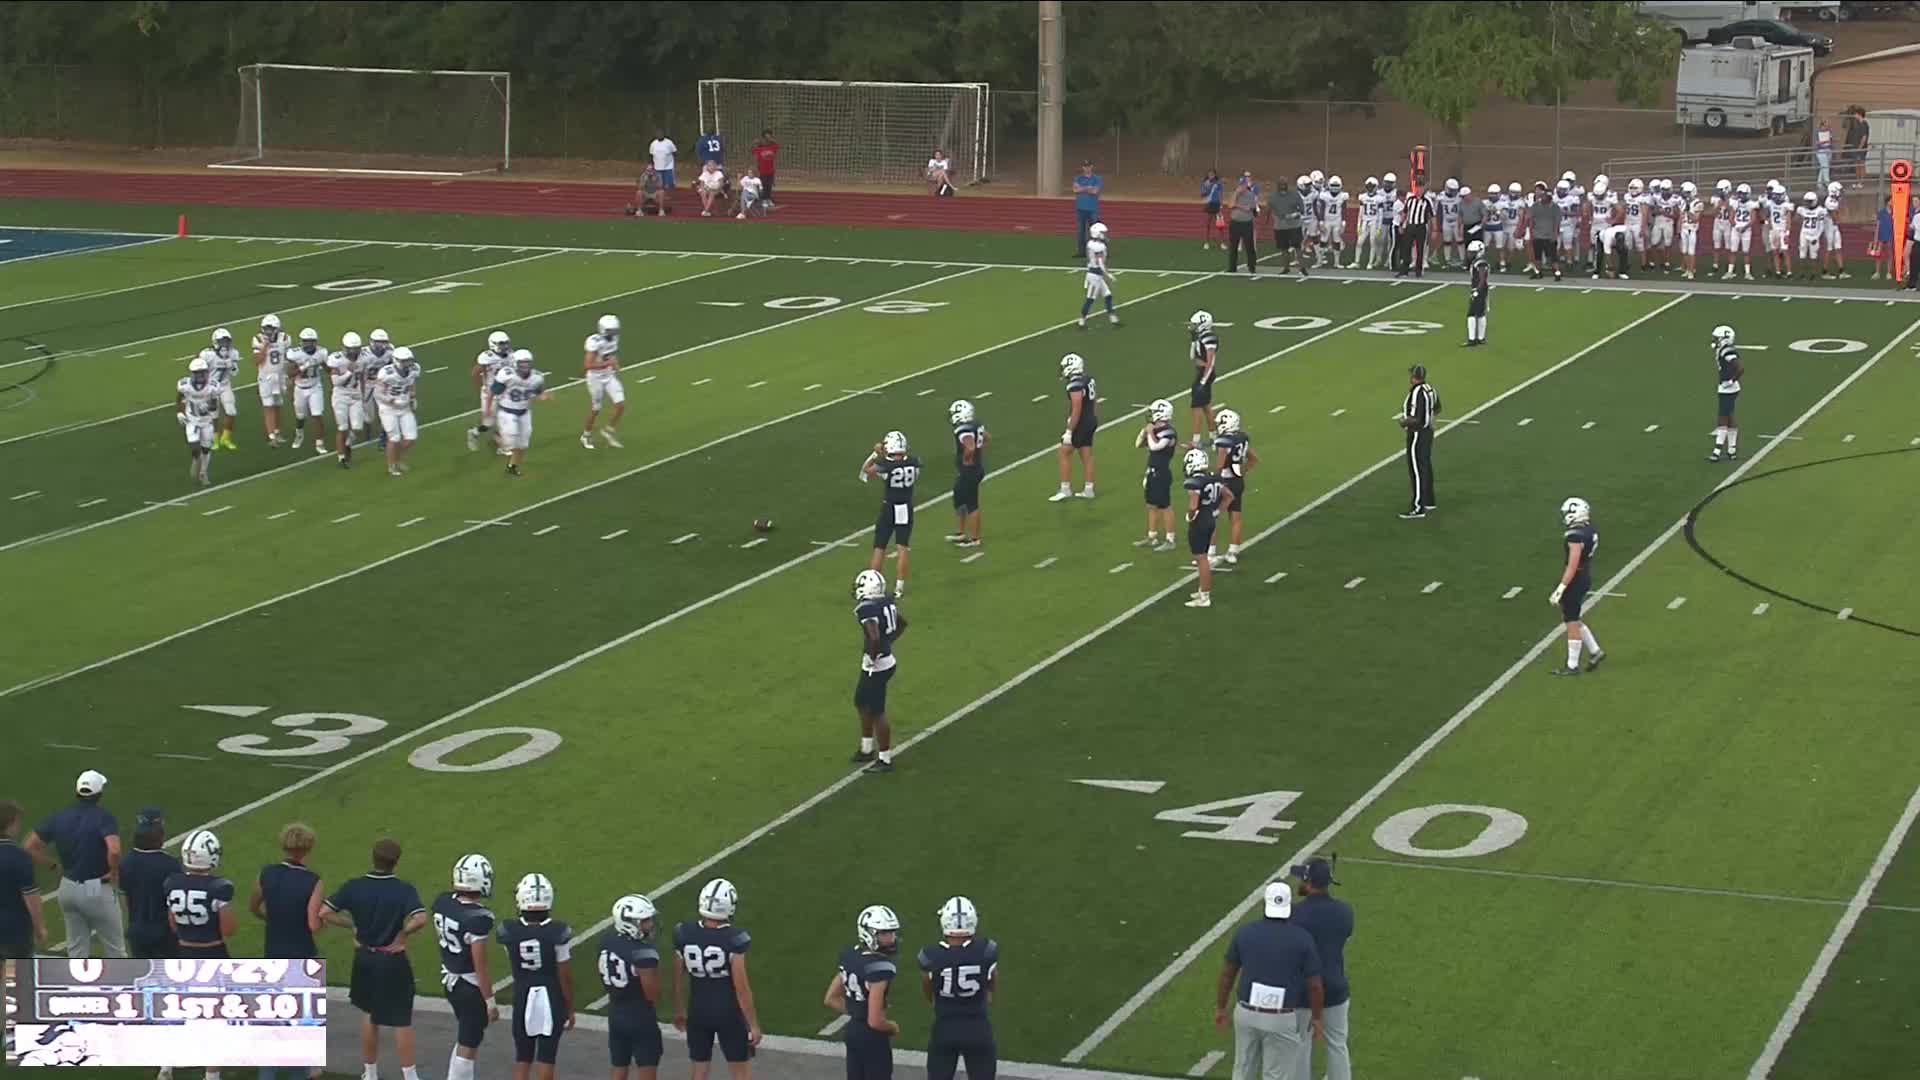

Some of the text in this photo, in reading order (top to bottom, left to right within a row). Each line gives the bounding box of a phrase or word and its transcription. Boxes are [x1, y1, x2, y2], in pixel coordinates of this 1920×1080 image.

[707, 140, 720, 152] 13
[1329, 204, 1337, 214] 4
[1364, 204, 1377, 215] 15
[270, 350, 280, 365] 8
[890, 466, 915, 488] 28
[217, 712, 563, 773] 30
[1154, 790, 1528, 858] 40
[169, 889, 209, 925] 25
[519, 938, 542, 970] 9
[939, 965, 981, 997] 15
